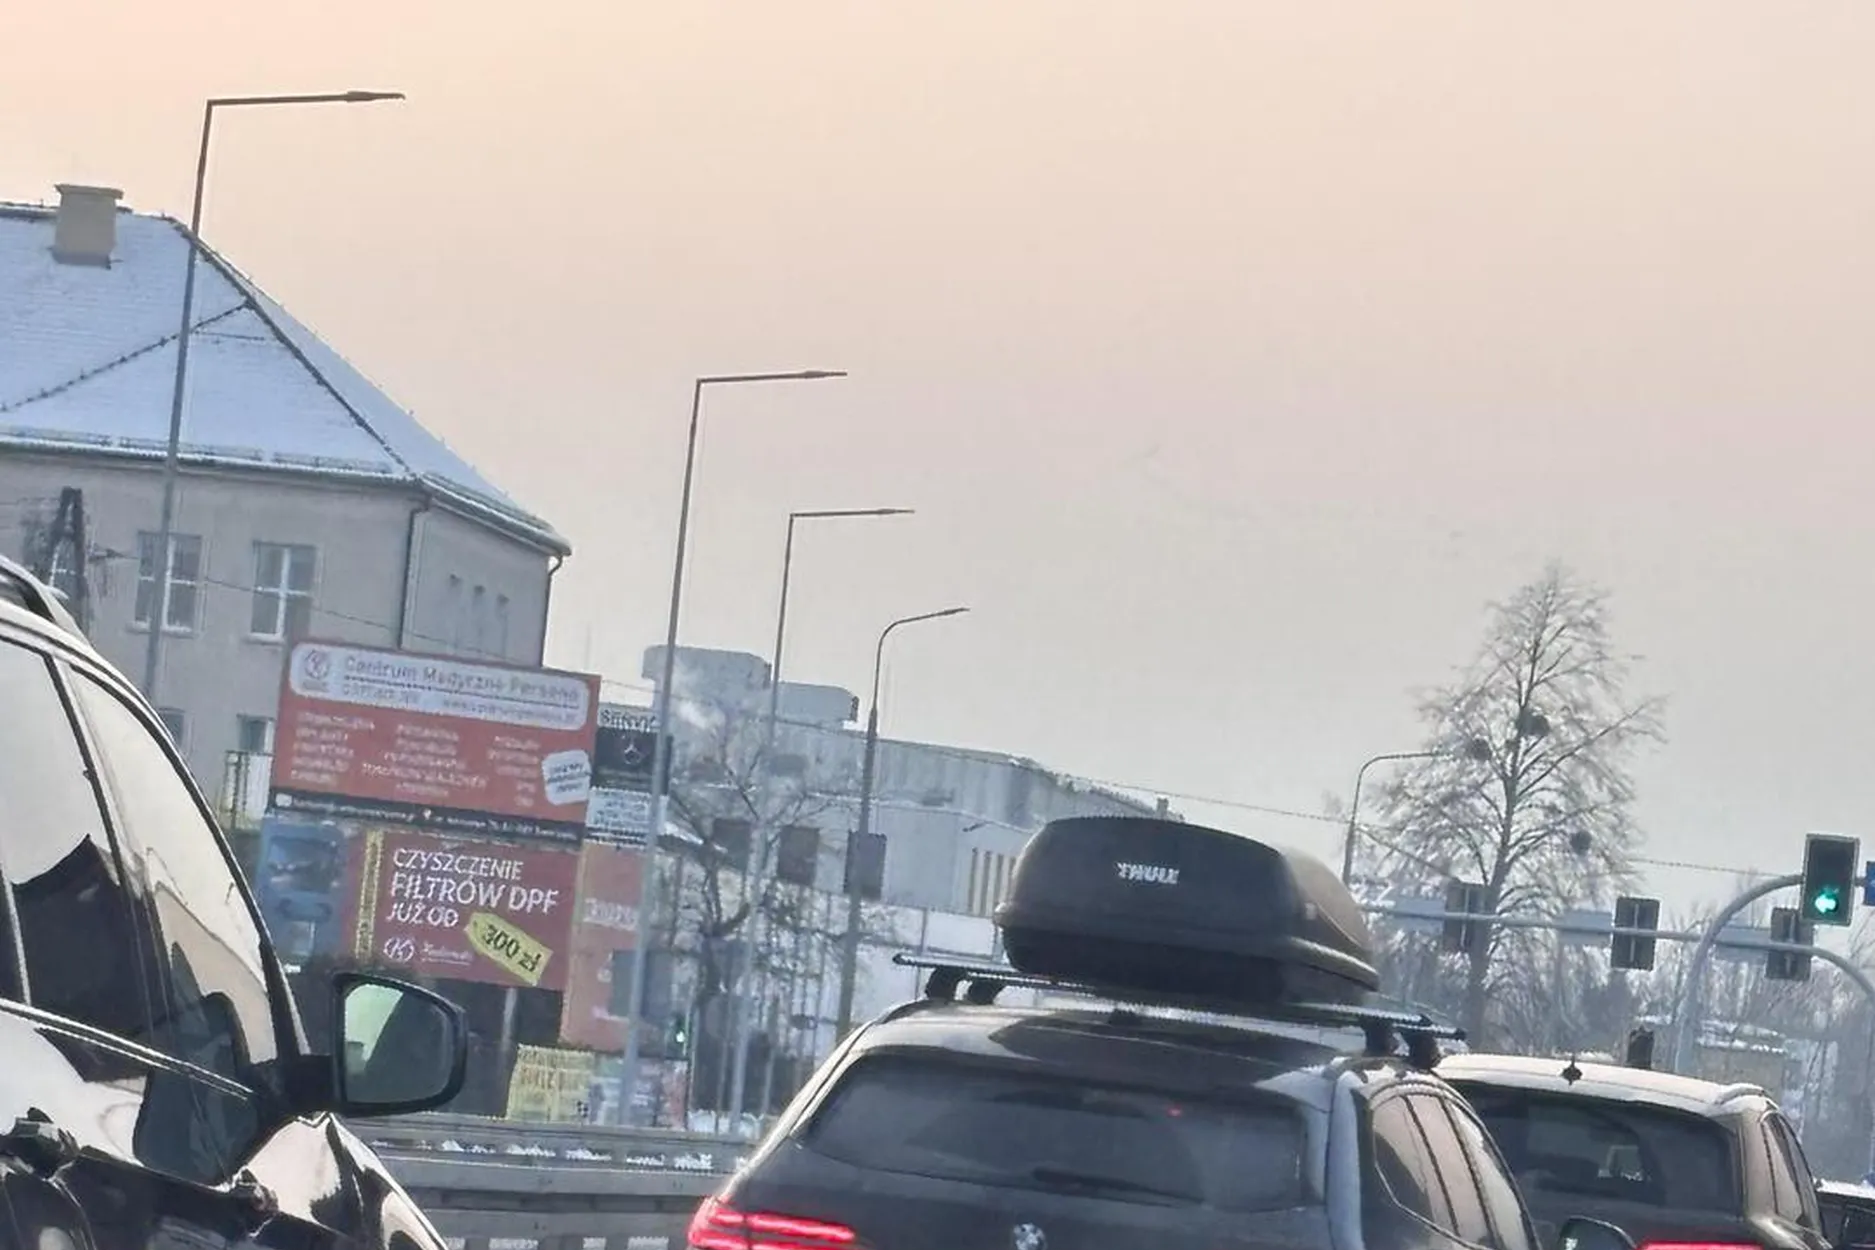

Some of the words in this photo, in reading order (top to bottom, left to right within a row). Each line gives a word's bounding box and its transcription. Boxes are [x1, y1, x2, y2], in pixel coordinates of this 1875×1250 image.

[344, 656, 417, 681] Centrum
[393, 848, 524, 881] CZYSZCZENIE
[1117, 862, 1180, 884] THULE
[390, 871, 506, 908] FILTRÓW
[508, 886, 560, 914] DPF
[386, 902, 424, 925] JUŻ
[427, 907, 459, 928] OD
[482, 924, 520, 959] 300
[518, 952, 542, 973] zł
